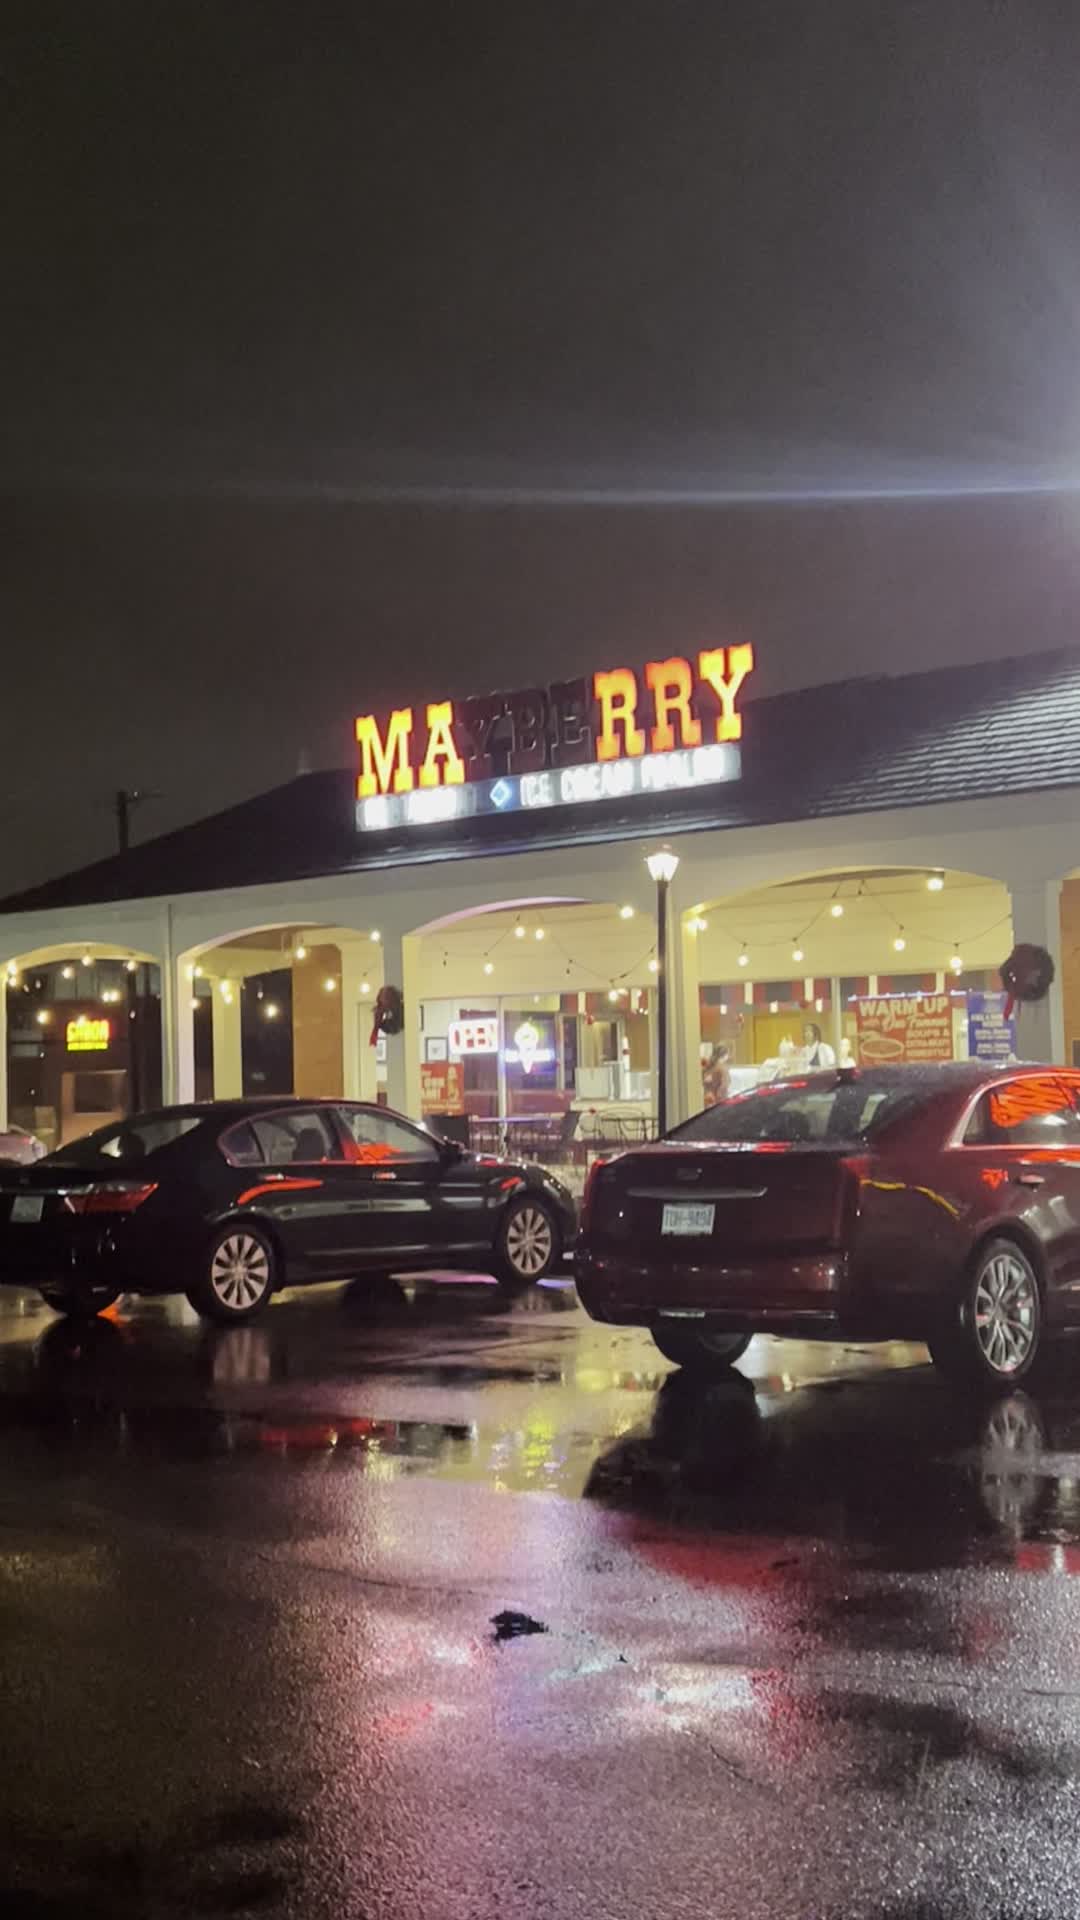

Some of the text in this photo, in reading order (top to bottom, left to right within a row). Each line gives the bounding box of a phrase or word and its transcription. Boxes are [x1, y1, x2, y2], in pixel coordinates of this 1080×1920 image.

[355, 643, 753, 798] MAYBERRY
[859, 996, 948, 1017] WARM UP
